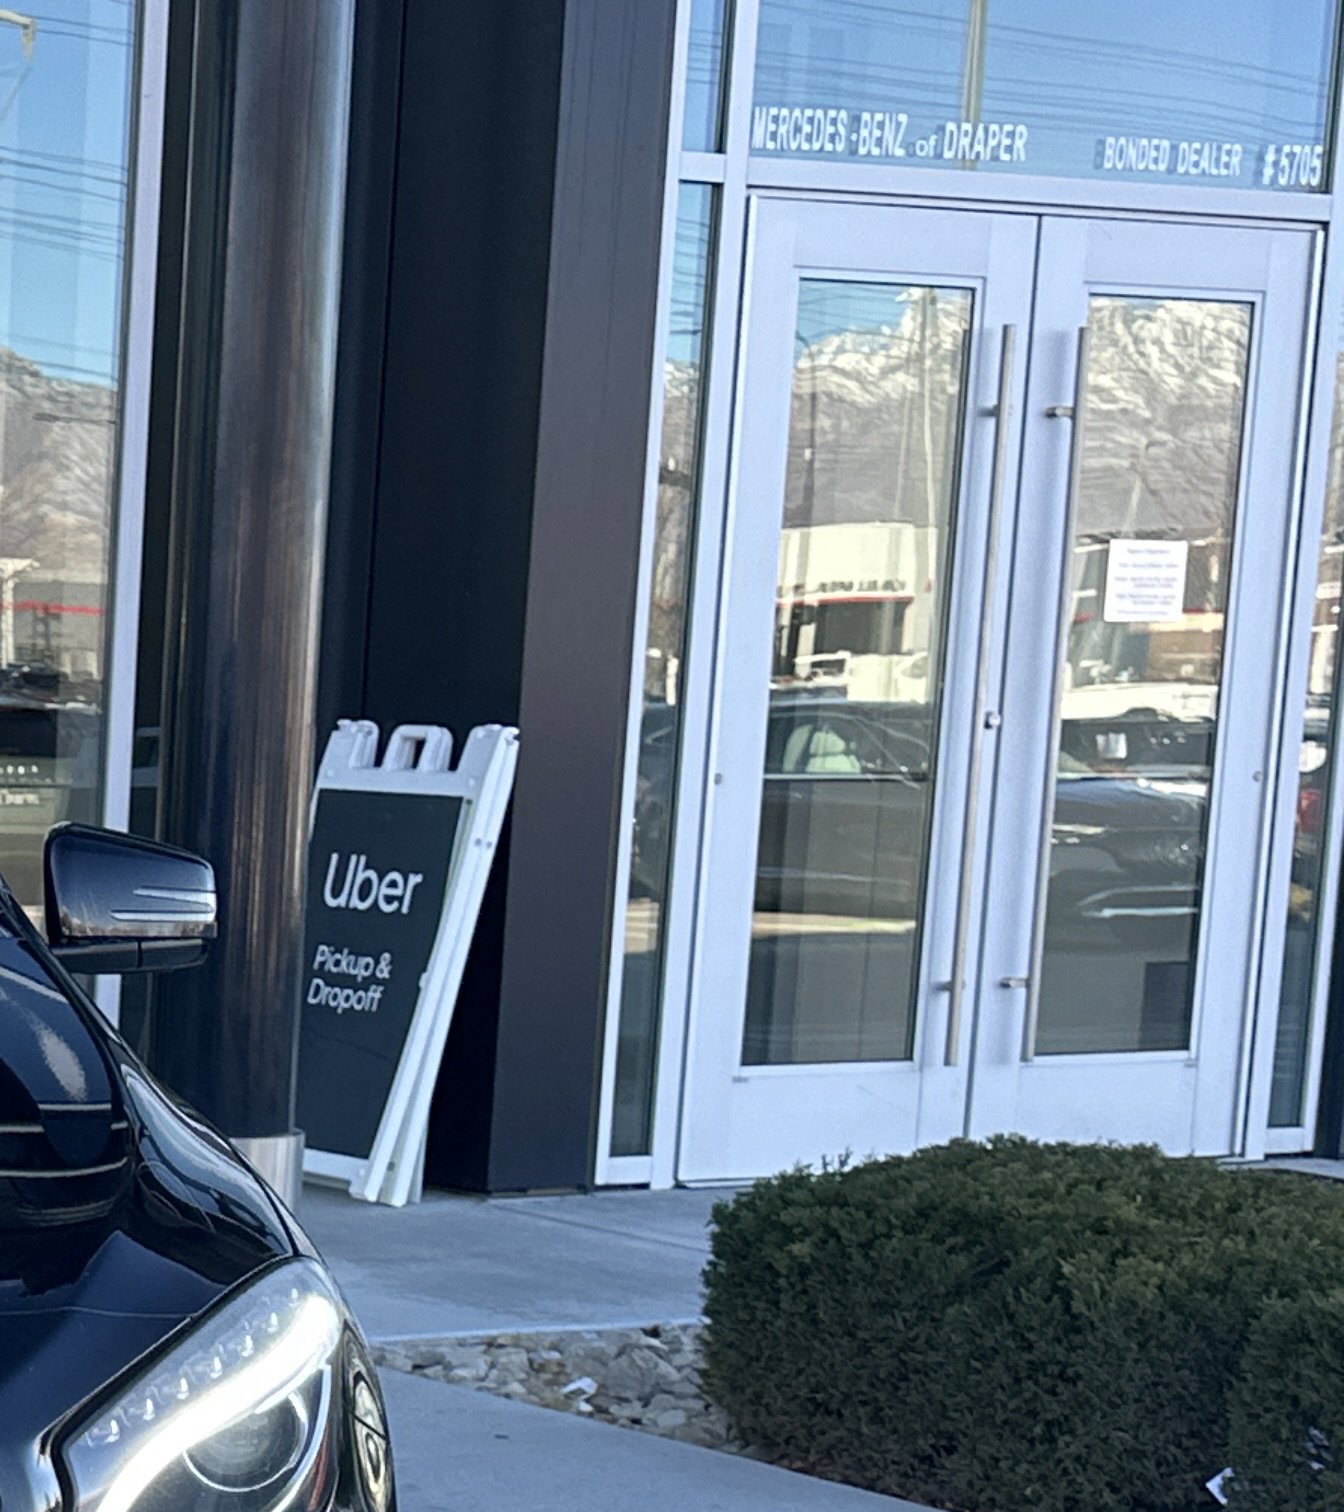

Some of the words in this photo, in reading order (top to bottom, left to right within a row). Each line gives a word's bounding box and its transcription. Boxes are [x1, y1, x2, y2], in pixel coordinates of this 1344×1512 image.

[915, 134, 936, 158] of
[942, 121, 1028, 163] DRAPER
[1102, 136, 1170, 172] BONDED
[1176, 141, 1243, 177] DEALER
[323, 852, 423, 914] Uber
[313, 944, 374, 982] Pickup
[375, 952, 392, 979] &
[307, 977, 385, 1014] Dropoff
